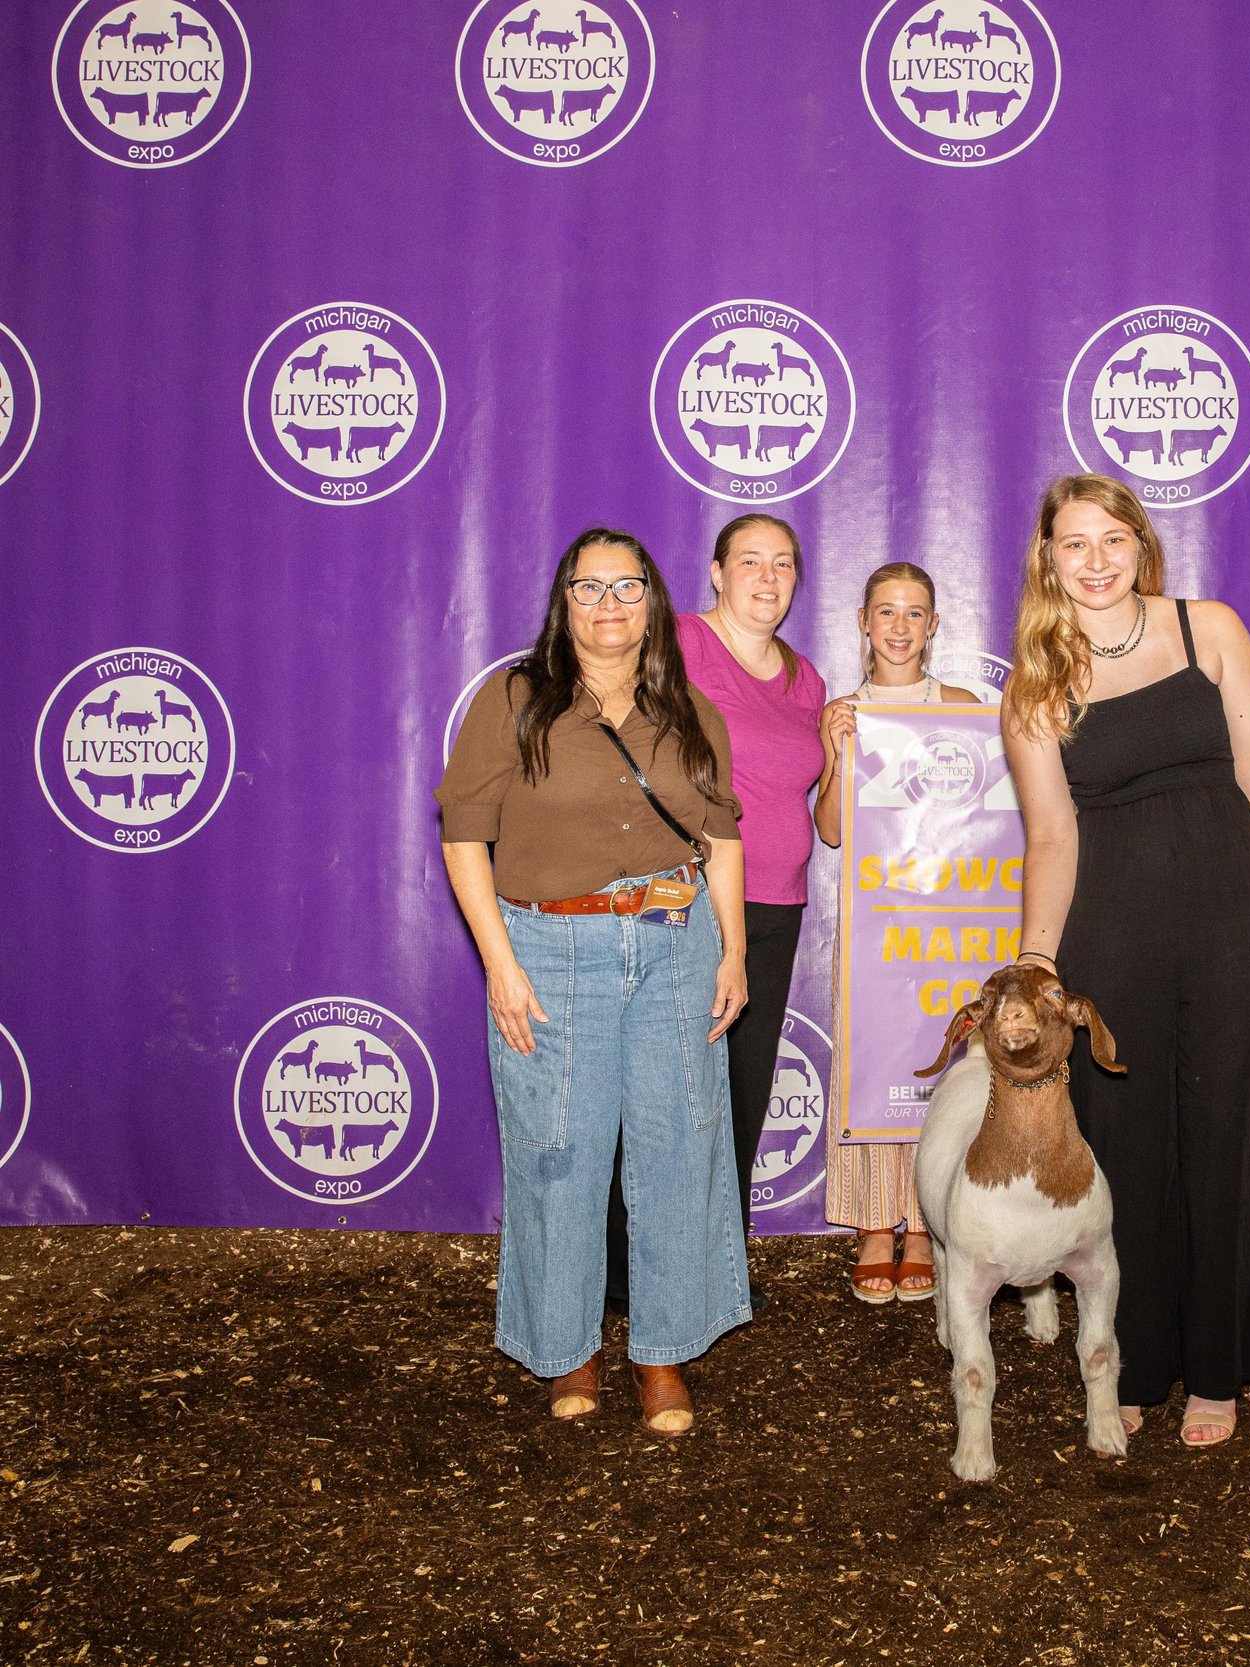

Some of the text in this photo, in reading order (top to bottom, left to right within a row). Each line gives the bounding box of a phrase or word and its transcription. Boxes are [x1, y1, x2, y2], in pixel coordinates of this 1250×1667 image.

[82, 60, 220, 81] LIVESTOCK
[486, 56, 625, 80] LIVESTOCK
[892, 58, 1030, 84] LIVESTOCK
[128, 145, 174, 163] expo
[533, 144, 580, 161] expo
[939, 143, 986, 161] expo
[305, 308, 391, 333] michigan
[712, 305, 799, 332] michigan
[1123, 311, 1210, 336] michigan
[274, 394, 414, 416] LIVESTOCK
[681, 391, 824, 417] LIVESTOCK
[1095, 397, 1235, 419] LIVESTOCK
[321, 482, 367, 500] expo
[730, 480, 777, 498] expo
[1144, 484, 1190, 502] expo
[96, 653, 182, 679] michigan
[66, 741, 204, 763] LIVESTOCK
[114, 829, 160, 847] expo
[859, 855, 1023, 892] SHOWC
[883, 926, 1022, 962] MARK
[919, 979, 982, 1016] GO
[294, 1003, 382, 1029] michigan
[266, 1090, 408, 1113] LIVESTOCK
[884, 1107, 911, 1118] OUR
[315, 1180, 361, 1198] expo
